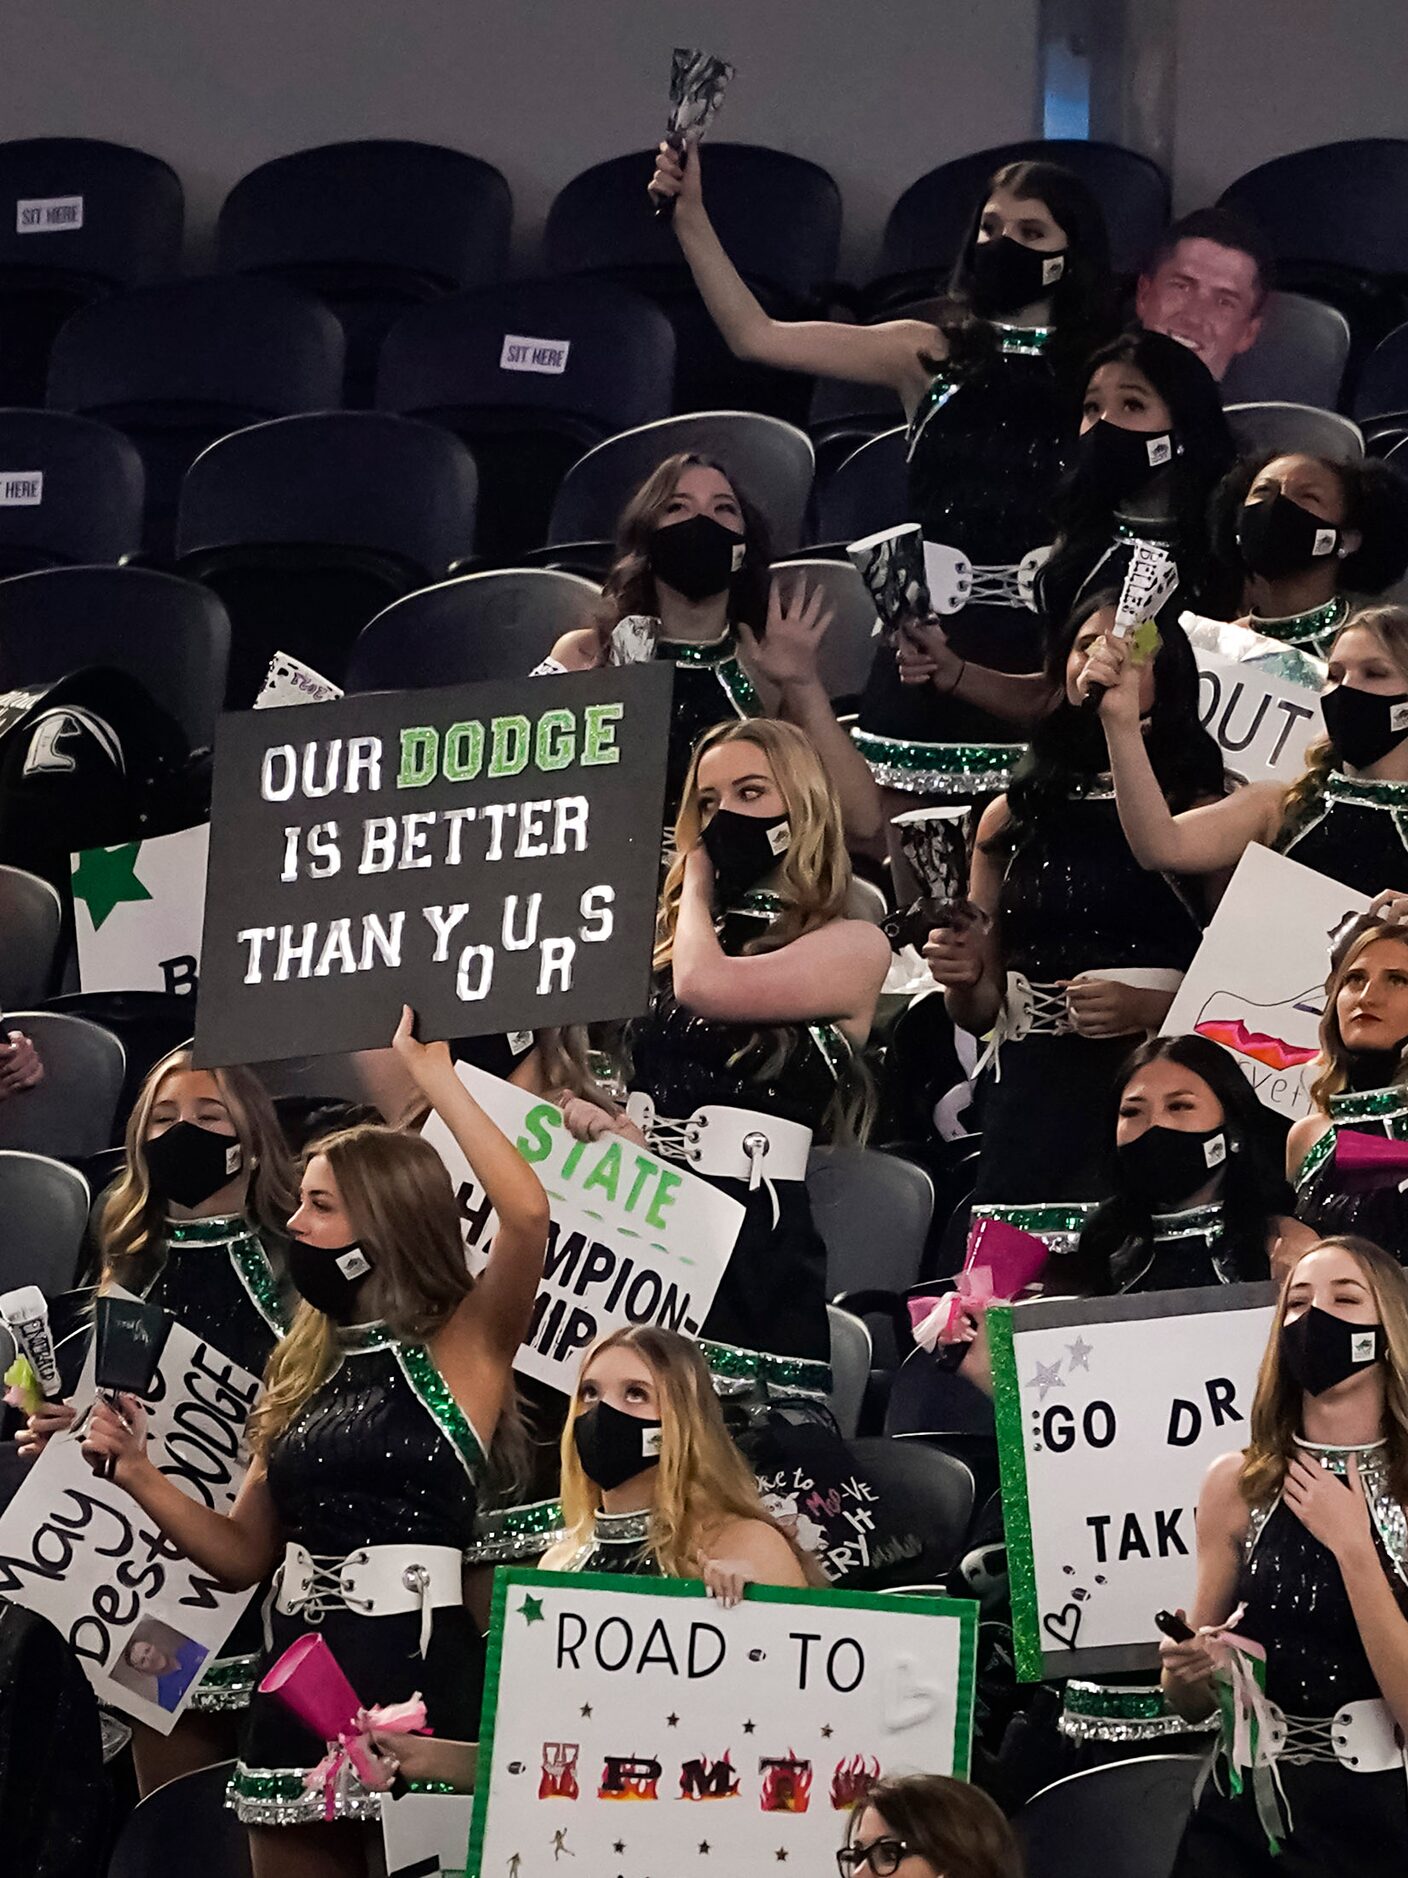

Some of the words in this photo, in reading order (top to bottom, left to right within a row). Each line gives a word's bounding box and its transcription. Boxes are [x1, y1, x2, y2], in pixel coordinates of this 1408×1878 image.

[507, 345, 530, 363] SIT
[532, 348, 564, 367] HERE
[5, 481, 39, 498] HERE
[260, 736, 382, 801] OUR
[397, 702, 625, 788] DODGE
[280, 820, 342, 882] IS
[358, 796, 590, 875] BETTER
[237, 911, 405, 985] THAN
[422, 884, 617, 1001] YOURS
[516, 1104, 683, 1230] STATE
[1043, 1400, 1117, 1454] GO
[1166, 1376, 1245, 1448] DR
[793, 1467, 816, 1491] to
[815, 1534, 869, 1582] ERY
[1086, 1507, 1200, 1563] TAK
[556, 1612, 727, 1679] ROAD
[789, 1632, 866, 1693] TO
